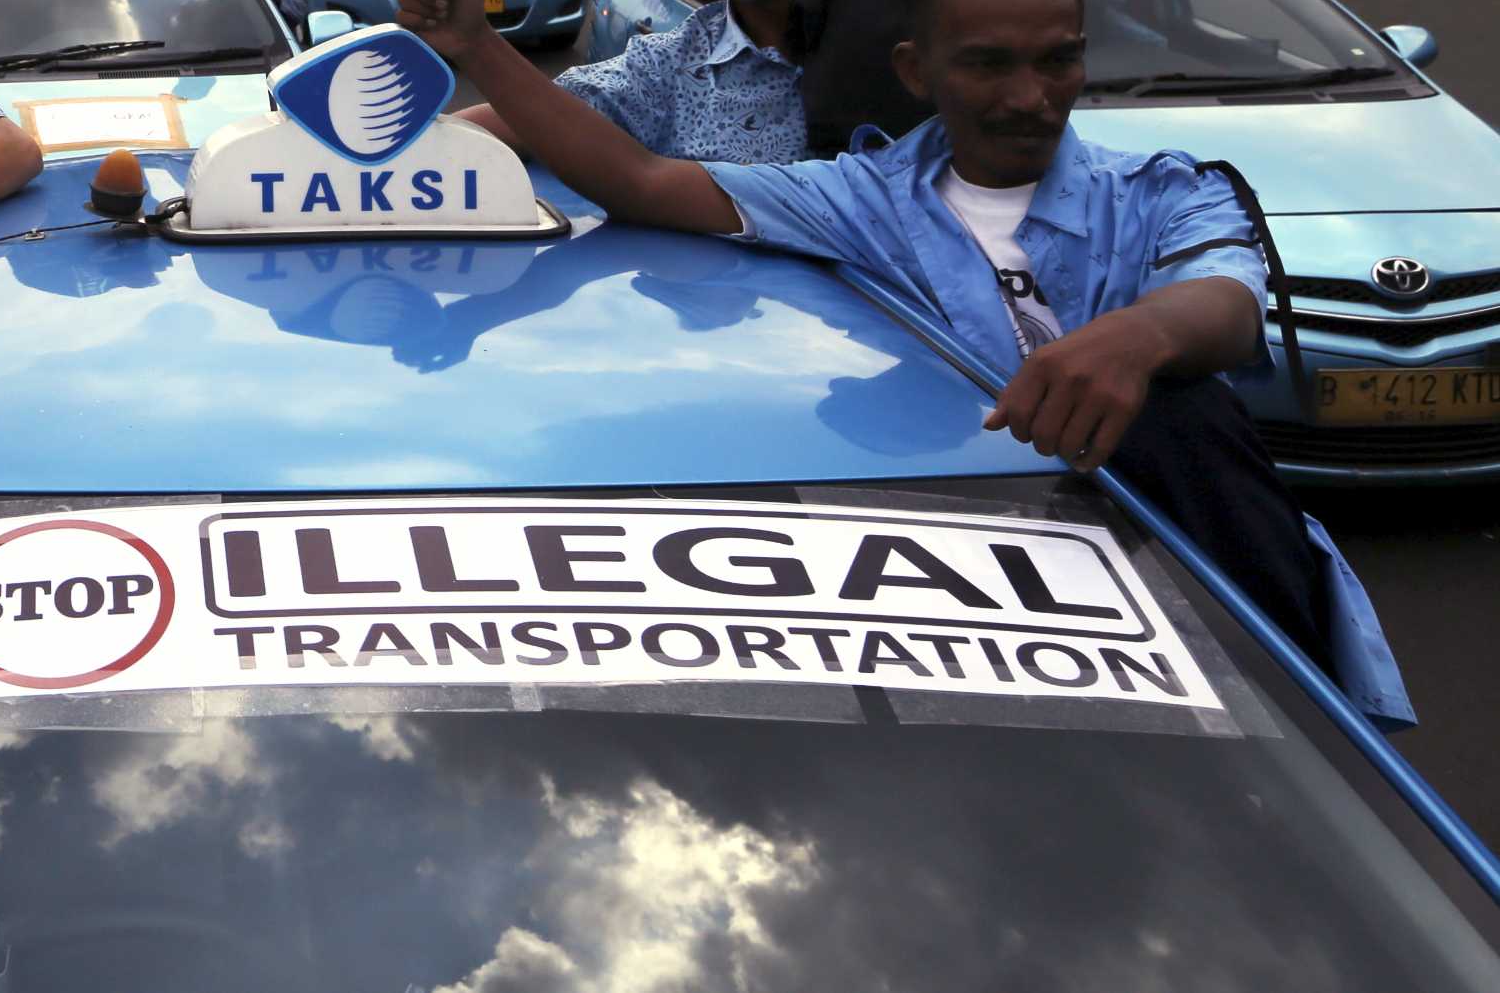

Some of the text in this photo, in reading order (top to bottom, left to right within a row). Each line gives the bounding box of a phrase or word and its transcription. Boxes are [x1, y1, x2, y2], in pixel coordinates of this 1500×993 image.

[250, 169, 478, 214] TAKSI
[1321, 375, 1338, 407] B
[1368, 374, 1437, 406] 1412
[222, 522, 1125, 620] ILLEGAL
[213, 620, 1189, 697] TRANSPORTATION
